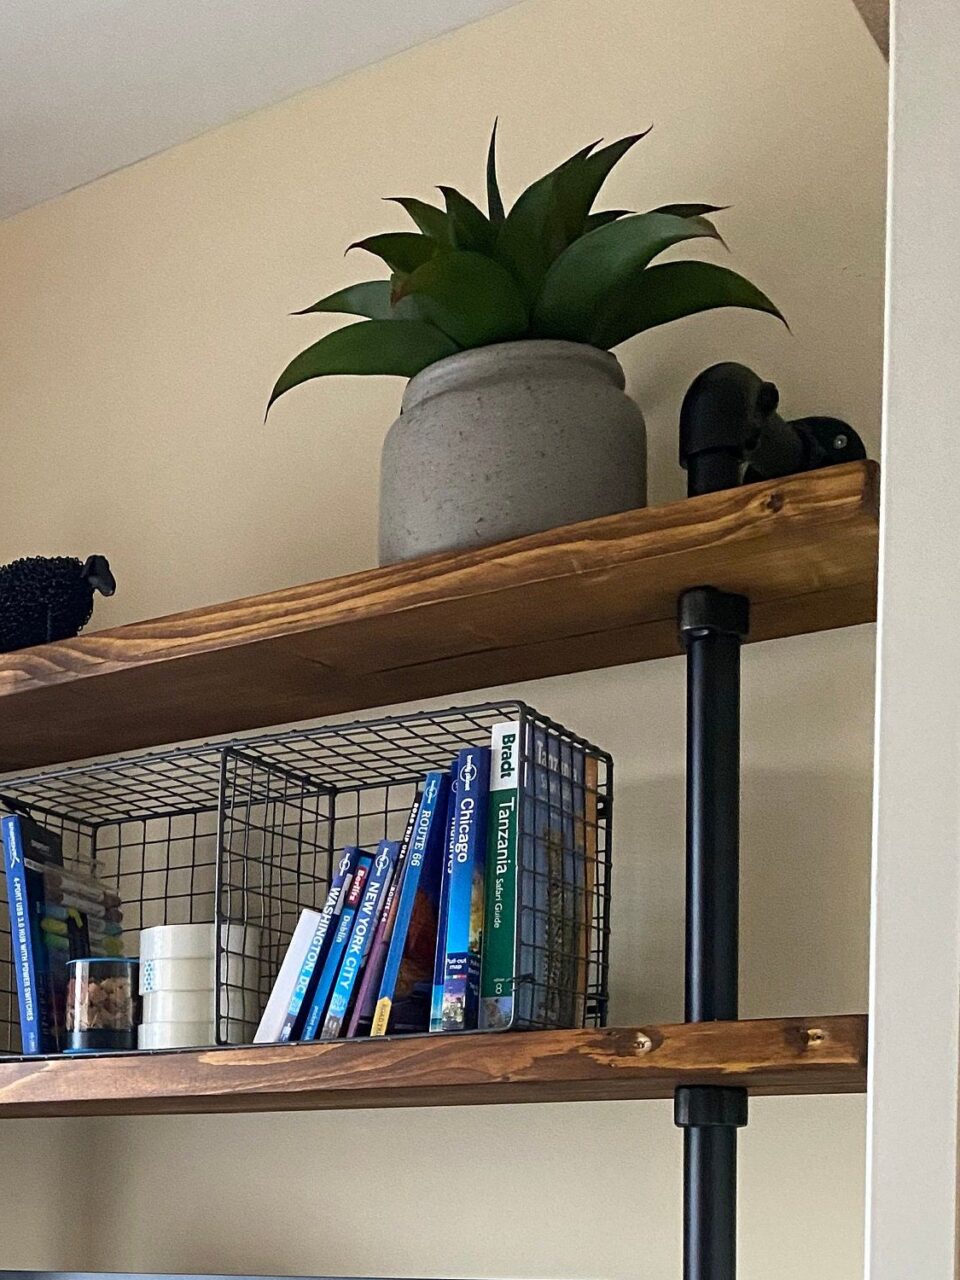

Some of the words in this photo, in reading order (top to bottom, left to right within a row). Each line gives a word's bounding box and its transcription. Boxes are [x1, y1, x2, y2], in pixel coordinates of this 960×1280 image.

[500, 733, 516, 779] Bradt
[409, 802, 419, 824] ROAD
[404, 825, 413, 843] TRIP
[414, 809, 432, 851] ROUTE
[455, 797, 475, 863] Chicago
[496, 796, 515, 875] Tanzania
[399, 843, 408, 859] USA
[410, 853, 422, 867] 66
[14, 877, 22, 900] 4-PORT
[349, 869, 365, 902] Berlitz
[494, 878, 504, 901] Safari
[16, 902, 24, 916] USB
[362, 881, 381, 916] NEW
[17, 917, 25, 927] 3.0
[493, 903, 503, 929] Guide
[19, 928, 27, 943] HUB
[335, 915, 351, 943] Dublin
[349, 917, 369, 956] YORK
[20, 944, 28, 961] WITH
[22, 962, 31, 986] POWER
[295, 976, 309, 996] DC
[341, 957, 357, 991] CITY
[24, 987, 34, 1021] SWITCHES
